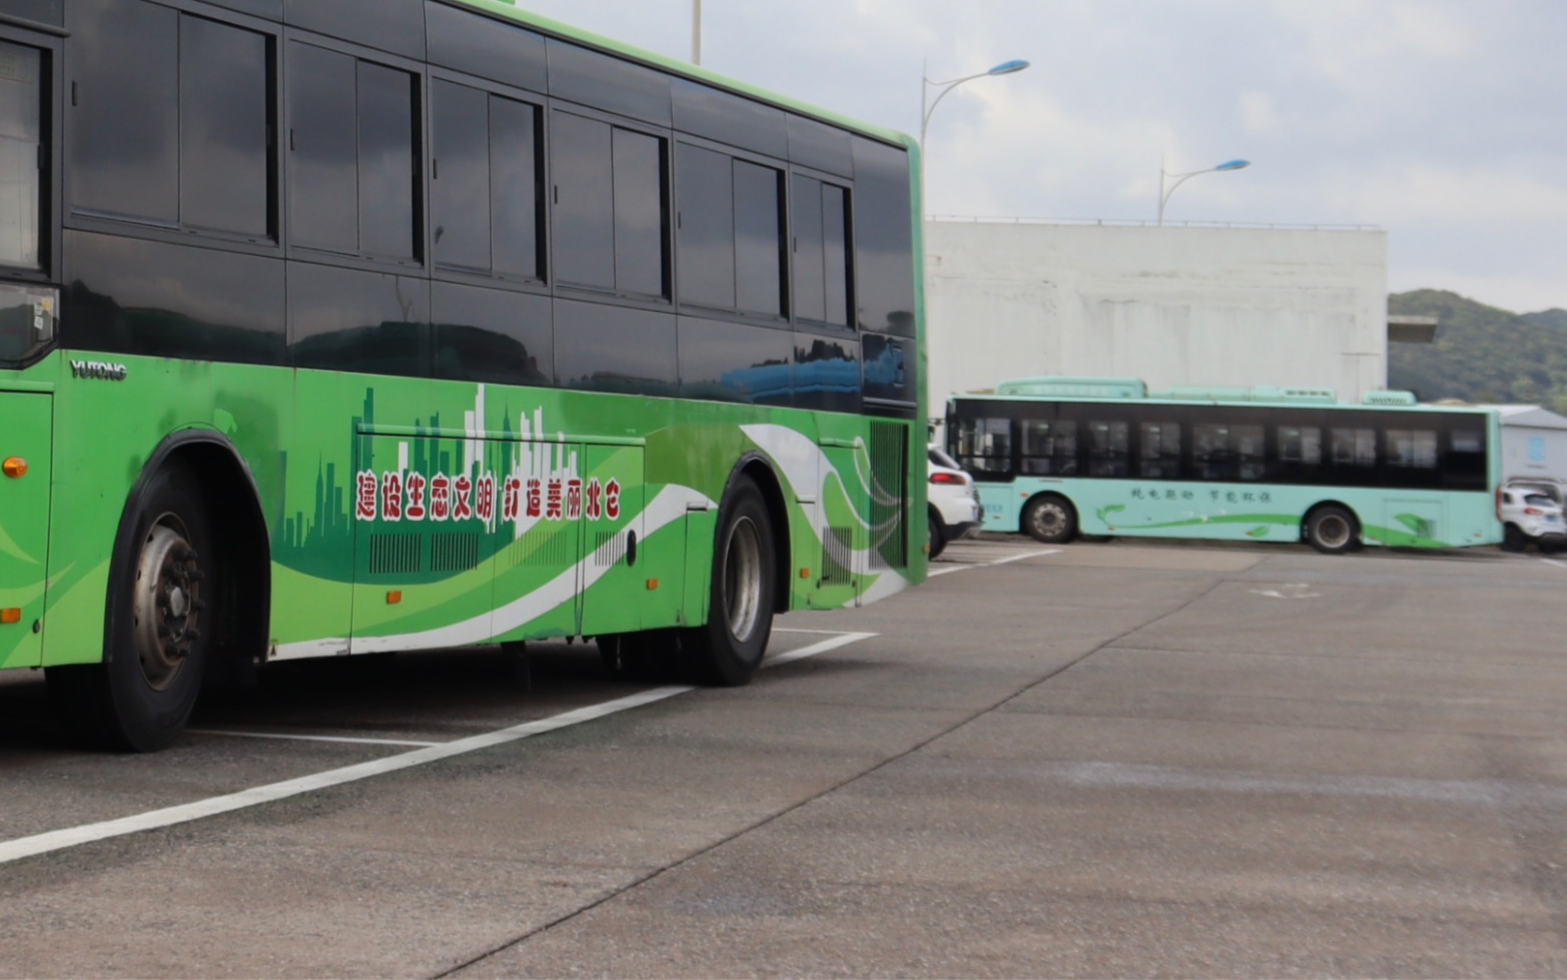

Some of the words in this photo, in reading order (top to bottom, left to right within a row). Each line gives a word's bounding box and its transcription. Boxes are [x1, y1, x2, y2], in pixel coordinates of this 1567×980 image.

[70, 359, 128, 381] YUTONG
[355, 470, 494, 520] 建设生态文明
[503, 474, 621, 520] 打造美丽北仑
